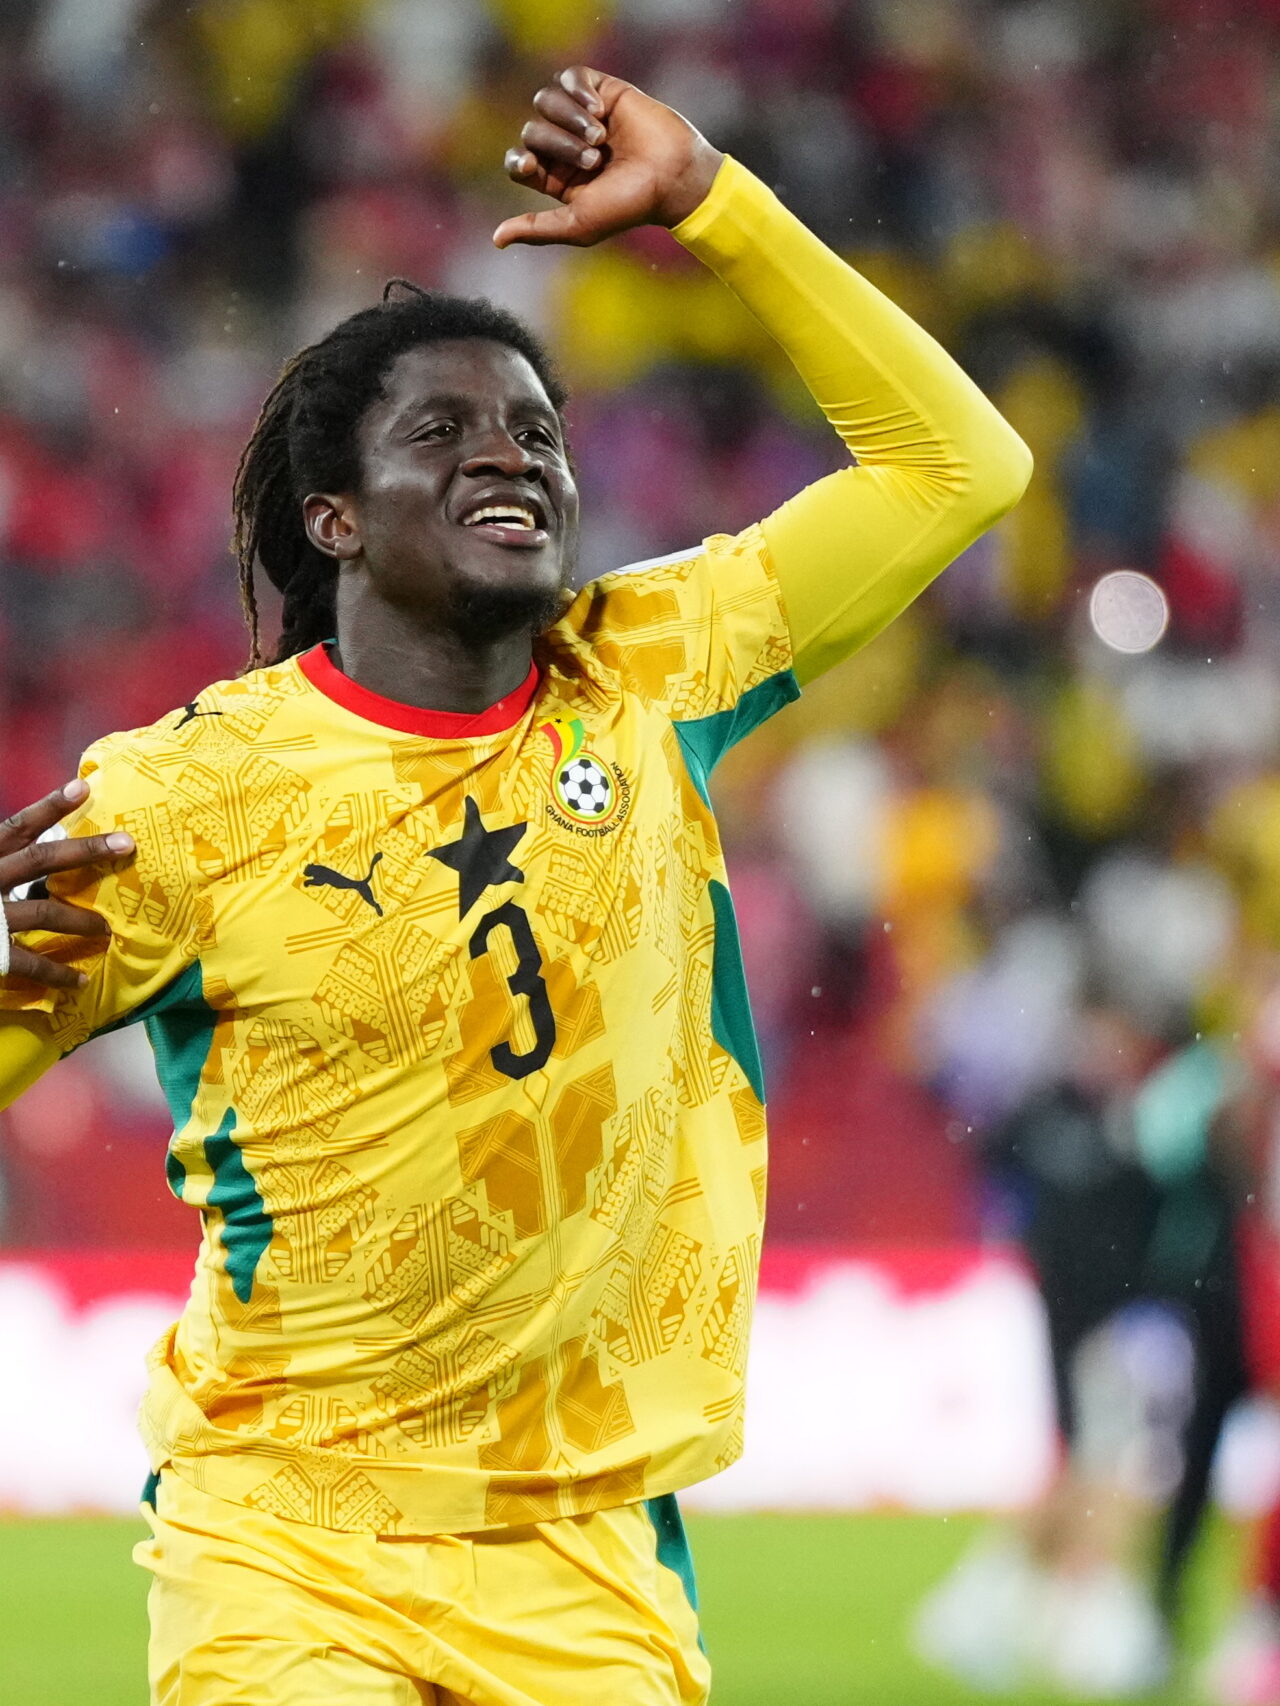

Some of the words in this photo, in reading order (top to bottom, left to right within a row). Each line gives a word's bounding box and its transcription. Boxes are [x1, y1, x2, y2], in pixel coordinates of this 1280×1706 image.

[545, 804, 574, 833] GHANA
[575, 820, 620, 838] FOOTBALL
[610, 761, 632, 822] ASSOCIATION
[469, 900, 556, 1080] 3
